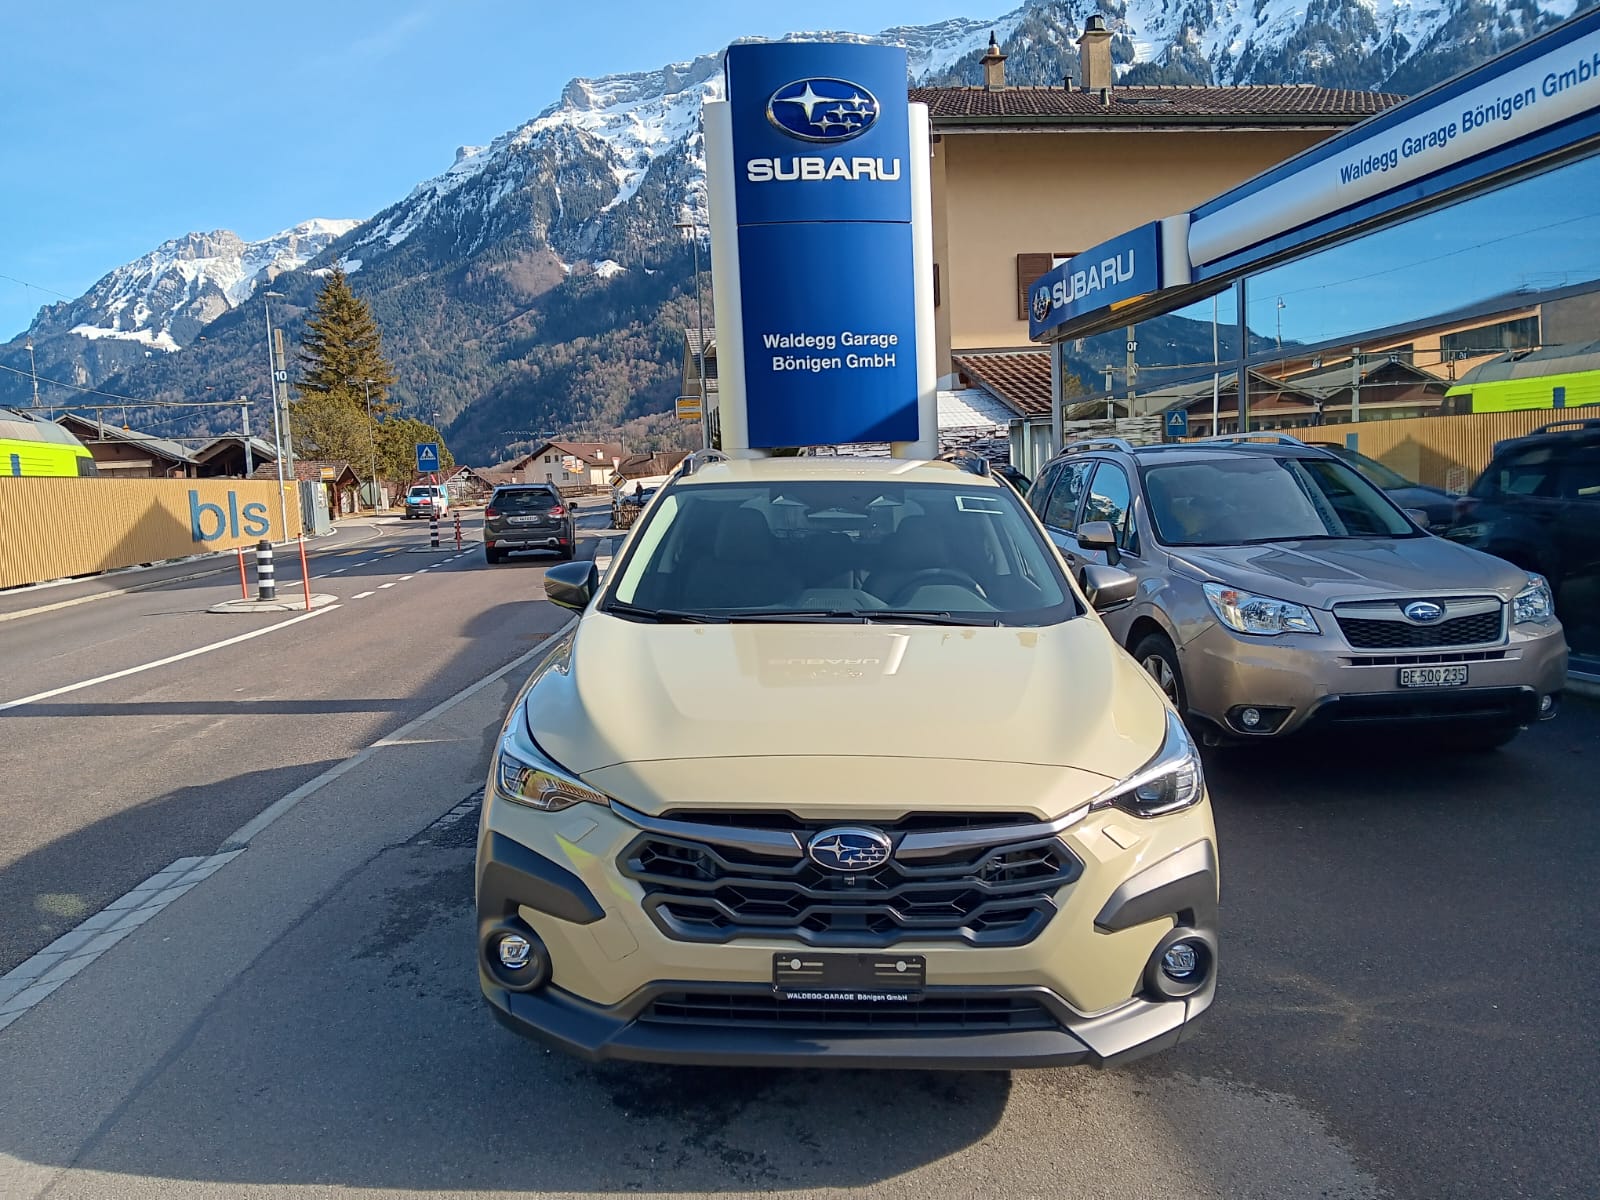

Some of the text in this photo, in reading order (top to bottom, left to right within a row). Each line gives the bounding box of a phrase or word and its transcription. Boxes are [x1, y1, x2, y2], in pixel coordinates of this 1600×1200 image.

[1340, 147, 1398, 185] Waldegg
[1402, 121, 1457, 159] Garage
[1462, 87, 1536, 133] Bönigen
[747, 157, 900, 182] SUBARU
[1052, 249, 1134, 309] SUBARU
[763, 331, 898, 349] Waldegg Garage
[772, 353, 896, 372] Bönigen GmbH
[274, 370, 288, 381] 10
[188, 490, 270, 542] bls
[1443, 668, 1465, 681] 235
[786, 992, 855, 1000] WALDEGG-GARAGE
[857, 993, 885, 1002] Bönigen
